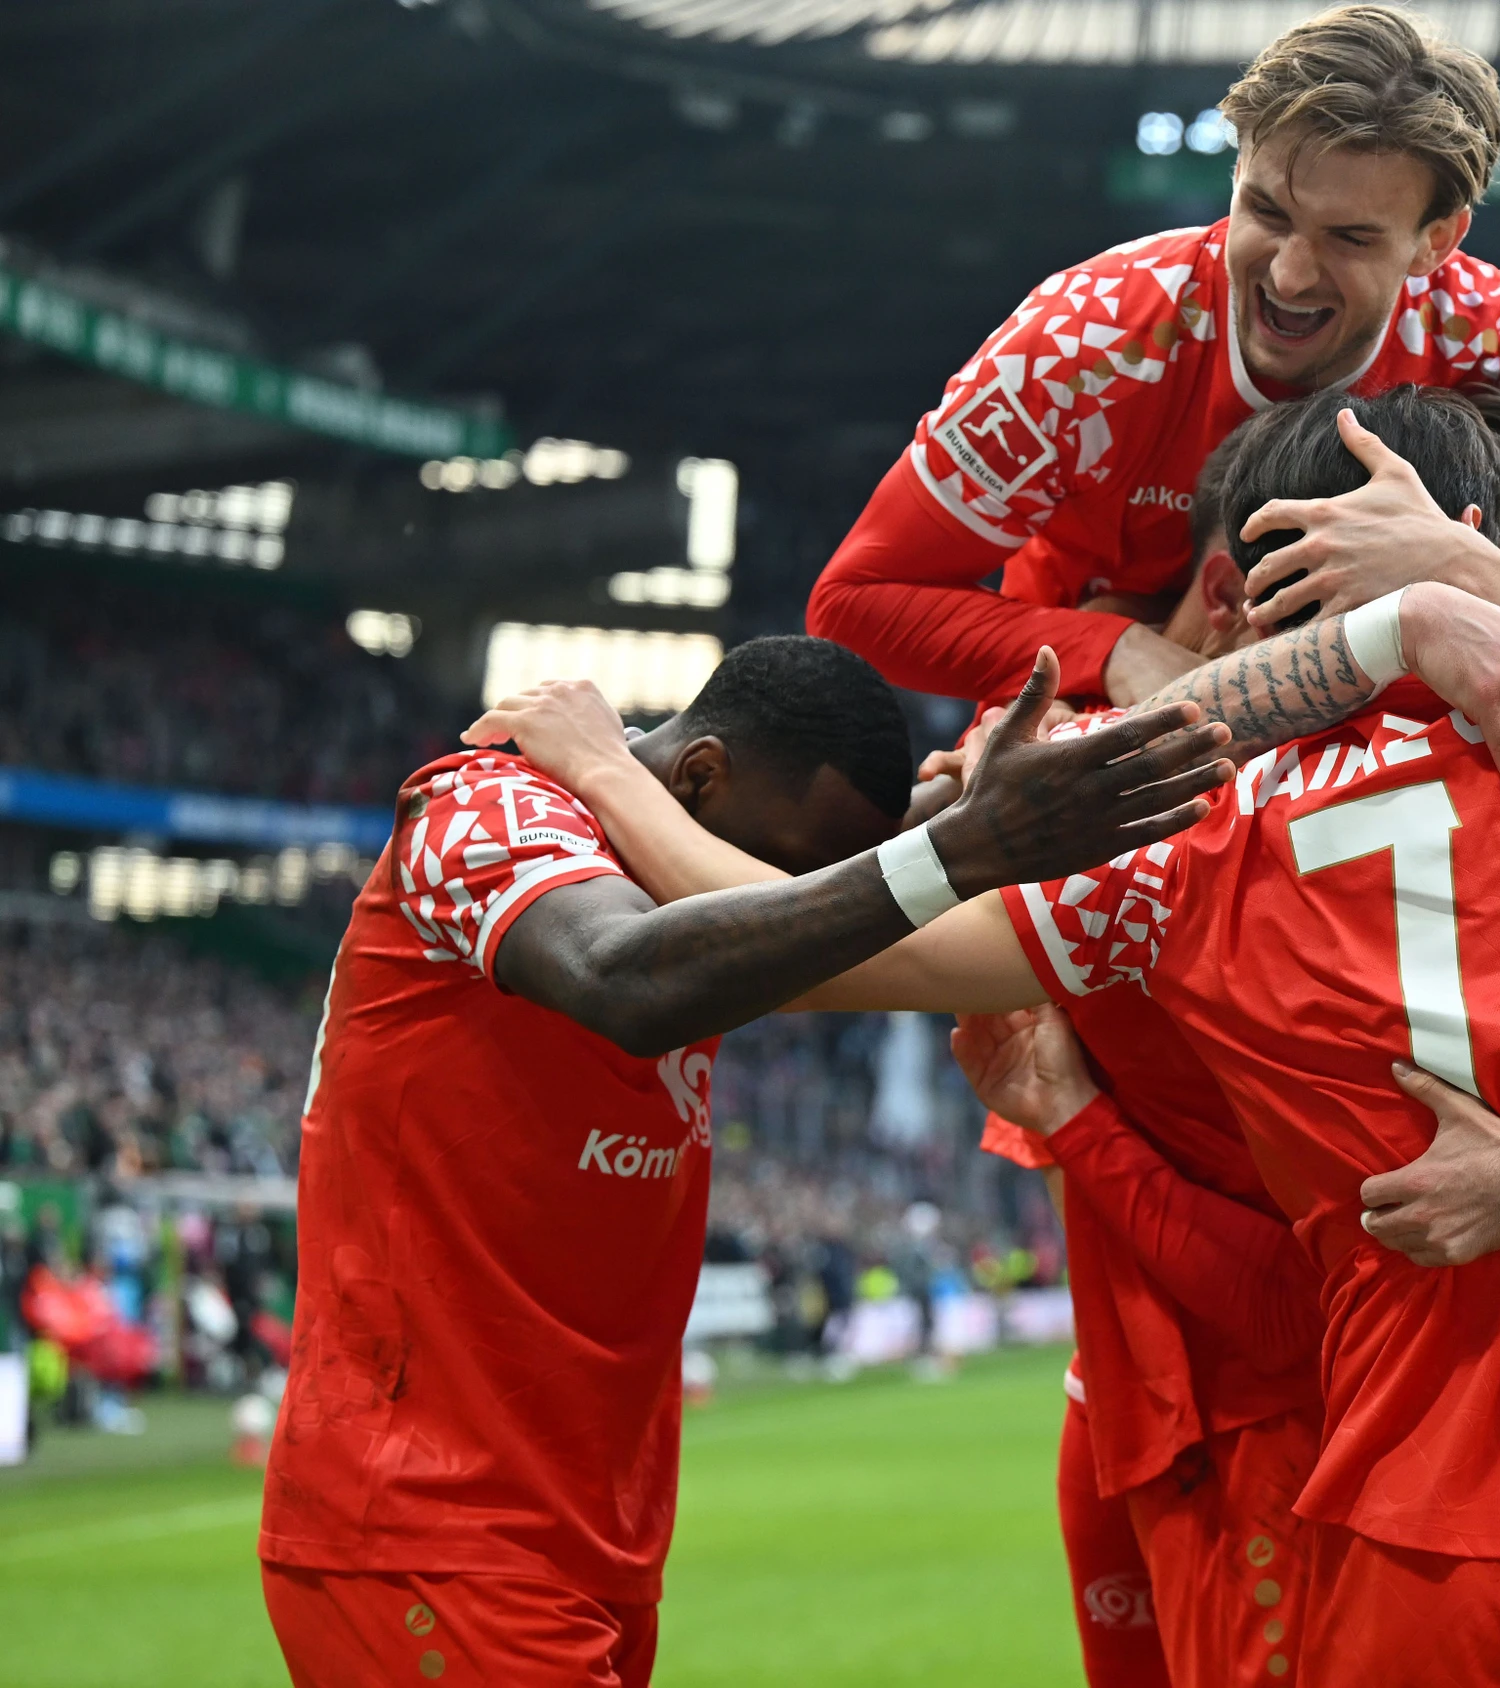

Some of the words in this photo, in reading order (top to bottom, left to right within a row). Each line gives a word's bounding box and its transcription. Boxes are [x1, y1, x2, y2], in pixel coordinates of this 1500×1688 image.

[945, 428, 1004, 493] BUNDESLIGA
[1128, 485, 1194, 511] JAKO
[519, 832, 593, 848] BUNDES
[1288, 778, 1484, 1101] 7
